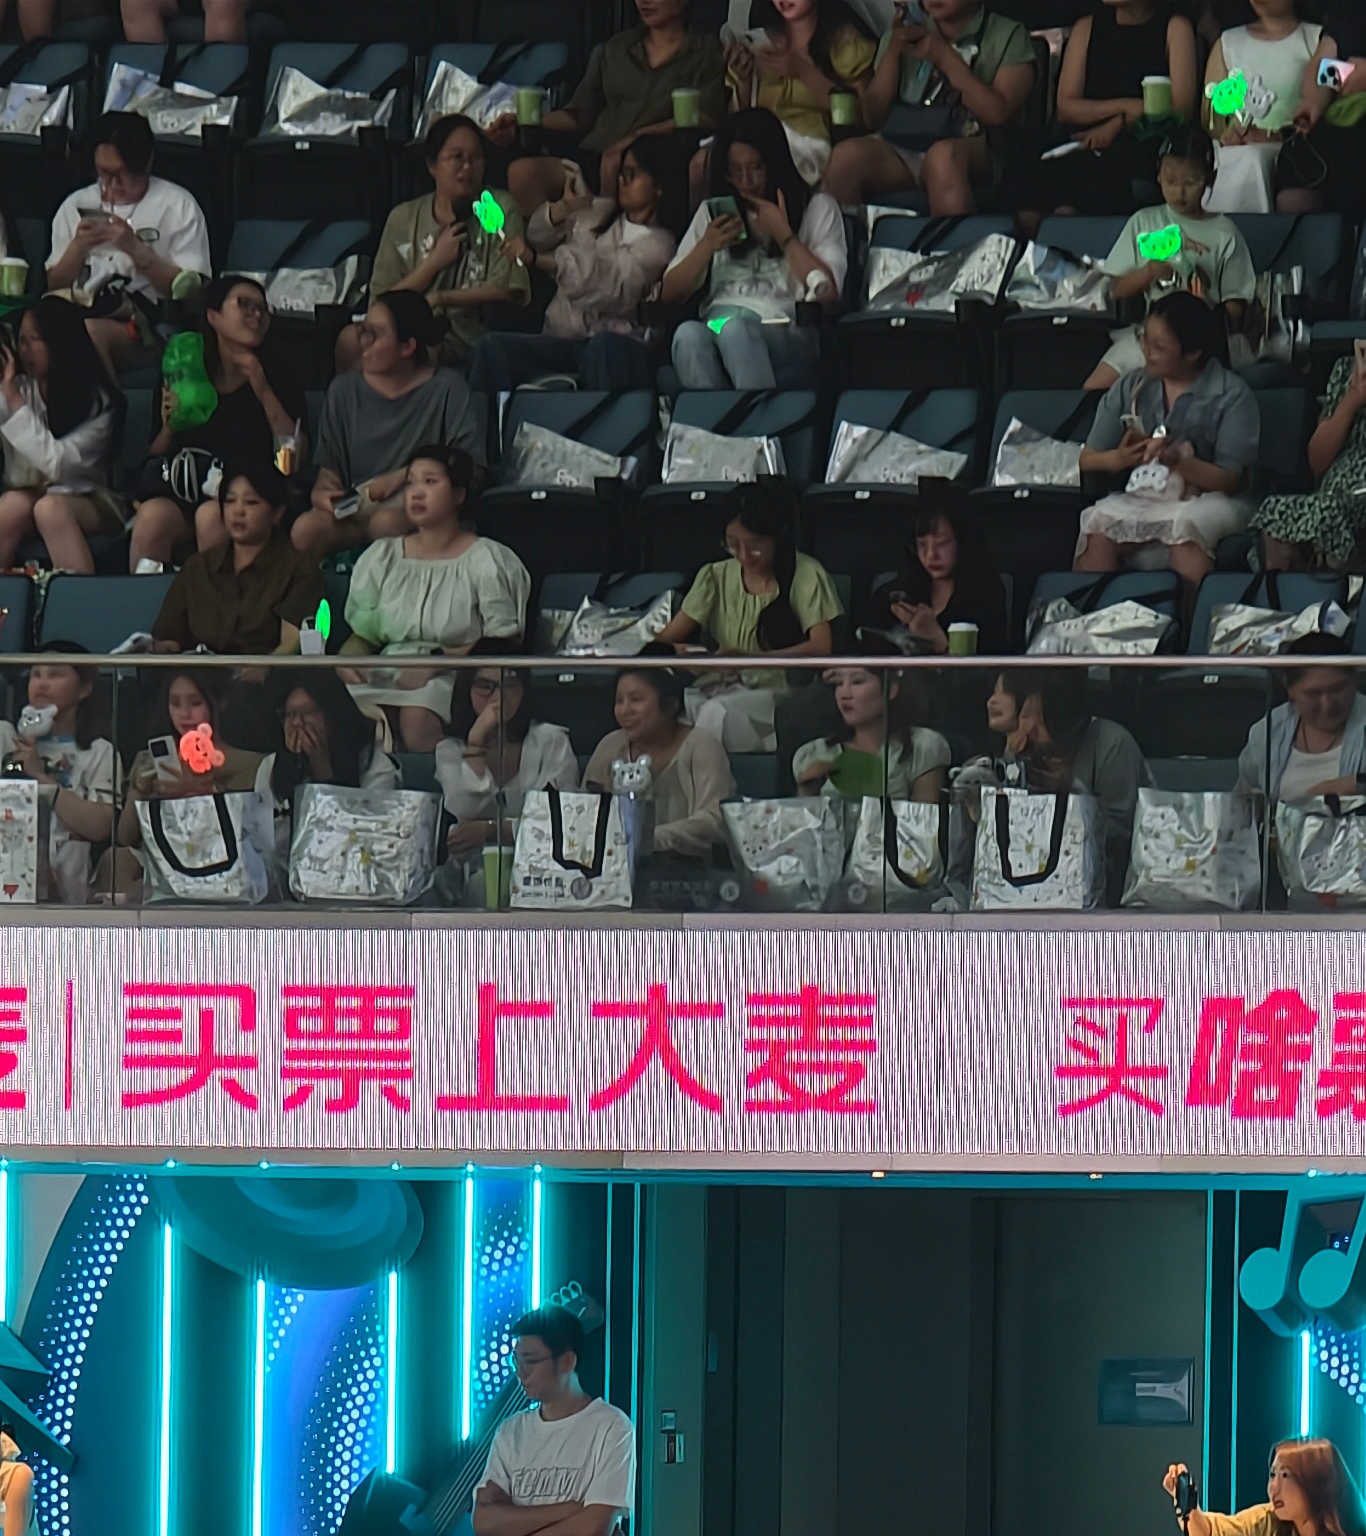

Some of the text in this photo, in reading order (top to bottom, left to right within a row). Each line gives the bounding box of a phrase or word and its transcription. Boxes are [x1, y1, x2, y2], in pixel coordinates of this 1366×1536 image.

[122, 980, 876, 1115] 买票上大麦
